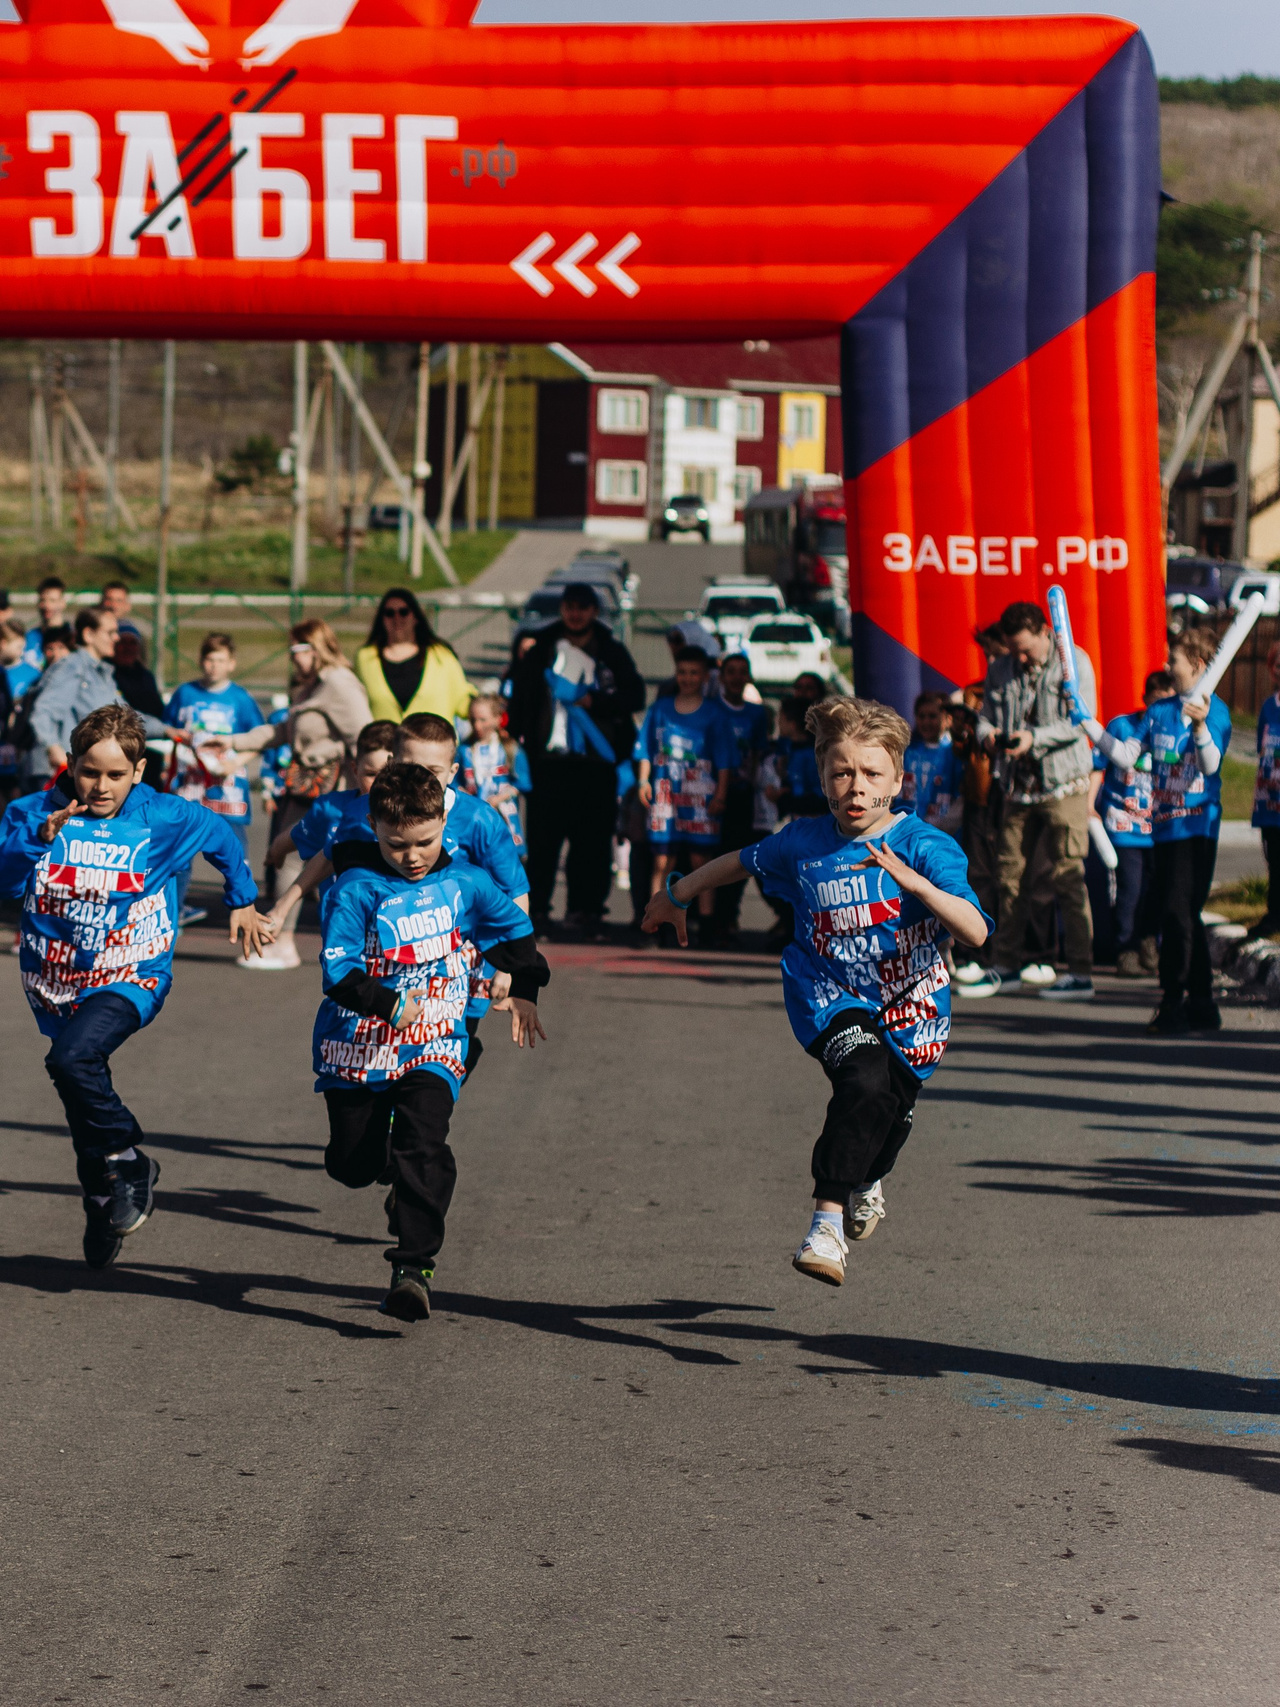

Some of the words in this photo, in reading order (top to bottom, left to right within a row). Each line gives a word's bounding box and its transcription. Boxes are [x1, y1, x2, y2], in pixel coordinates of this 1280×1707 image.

[883, 533, 1128, 576] ЗАБЕГ.РФ
[69, 839, 131, 869] 00522
[817, 875, 868, 907] 00511
[397, 905, 452, 942] 00518
